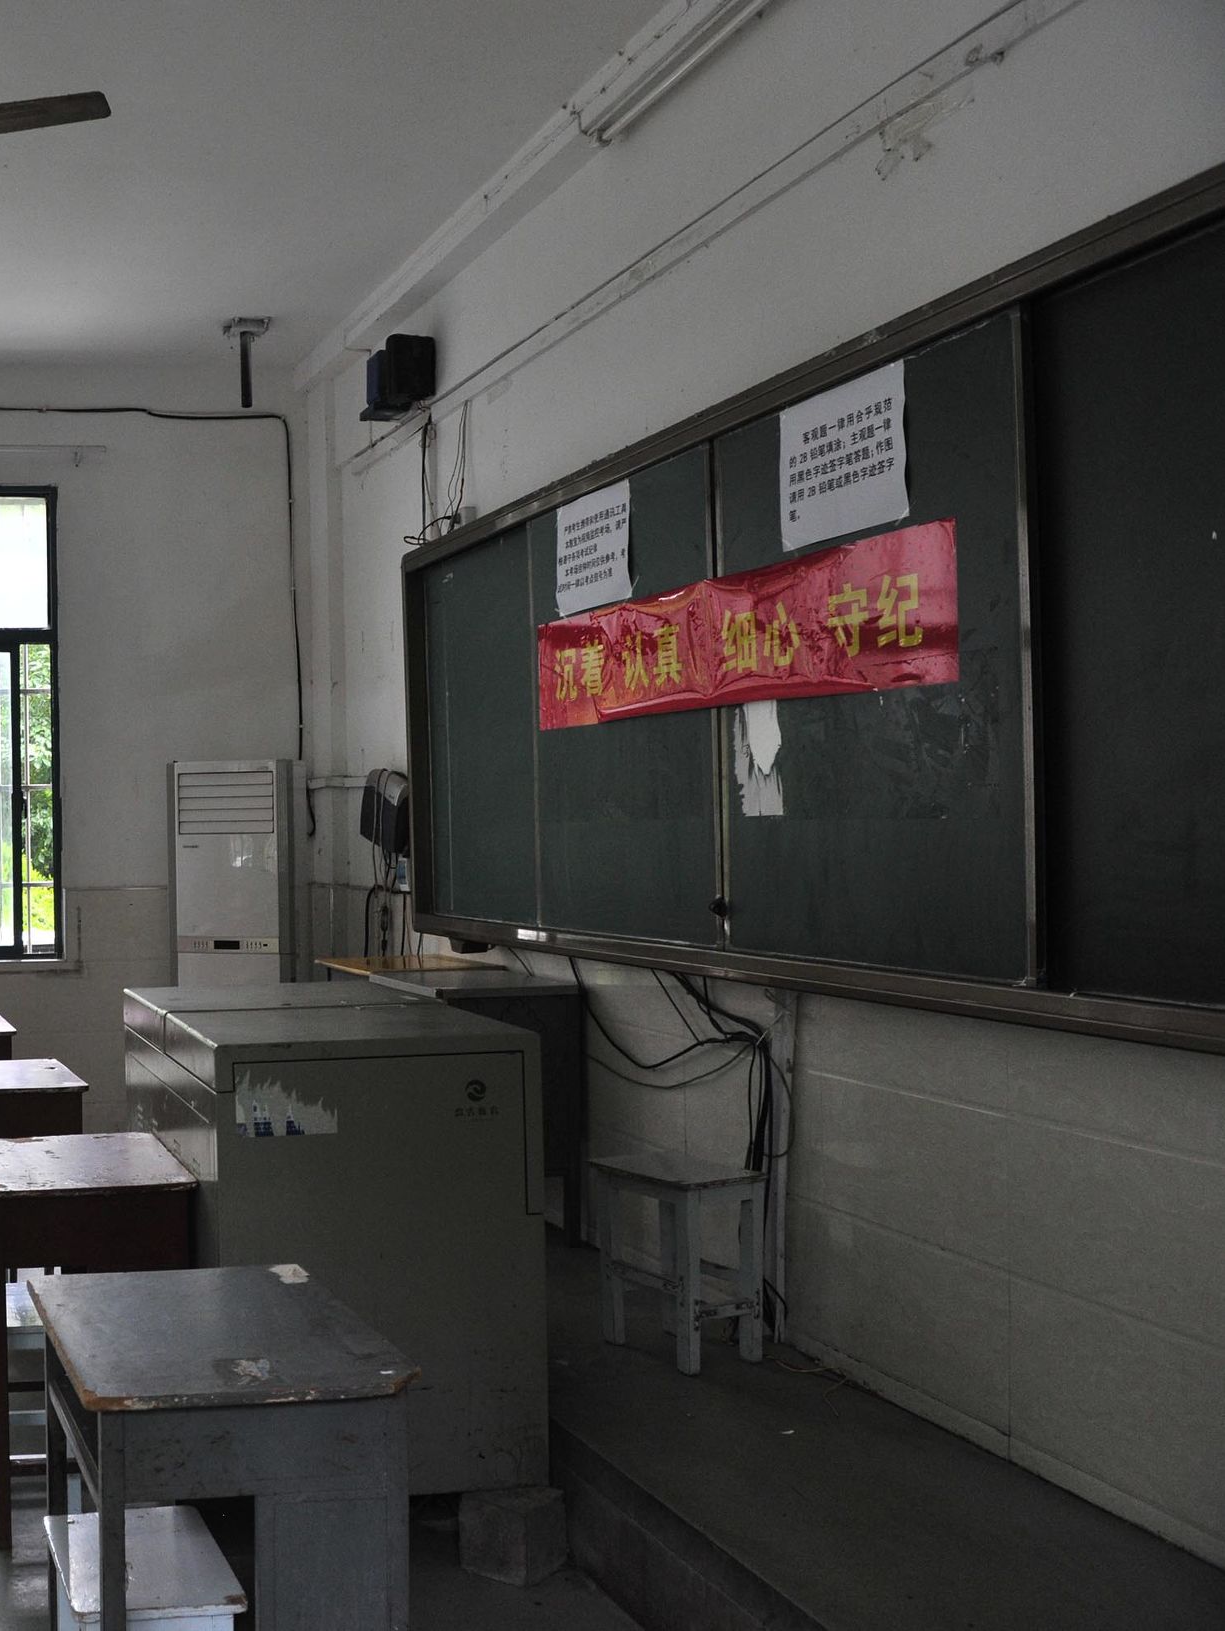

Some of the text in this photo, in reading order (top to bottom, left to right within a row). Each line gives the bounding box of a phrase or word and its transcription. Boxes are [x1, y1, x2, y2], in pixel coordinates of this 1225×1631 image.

[802, 398, 892, 444] 客观题一律用合乎规范
[789, 455, 797, 469] 的
[800, 451, 808, 462] 2B
[789, 458, 895, 504] 请用 2B 铅笔或黑色字迹签字
[554, 573, 924, 702] 沉着 认真 细心 守纪
